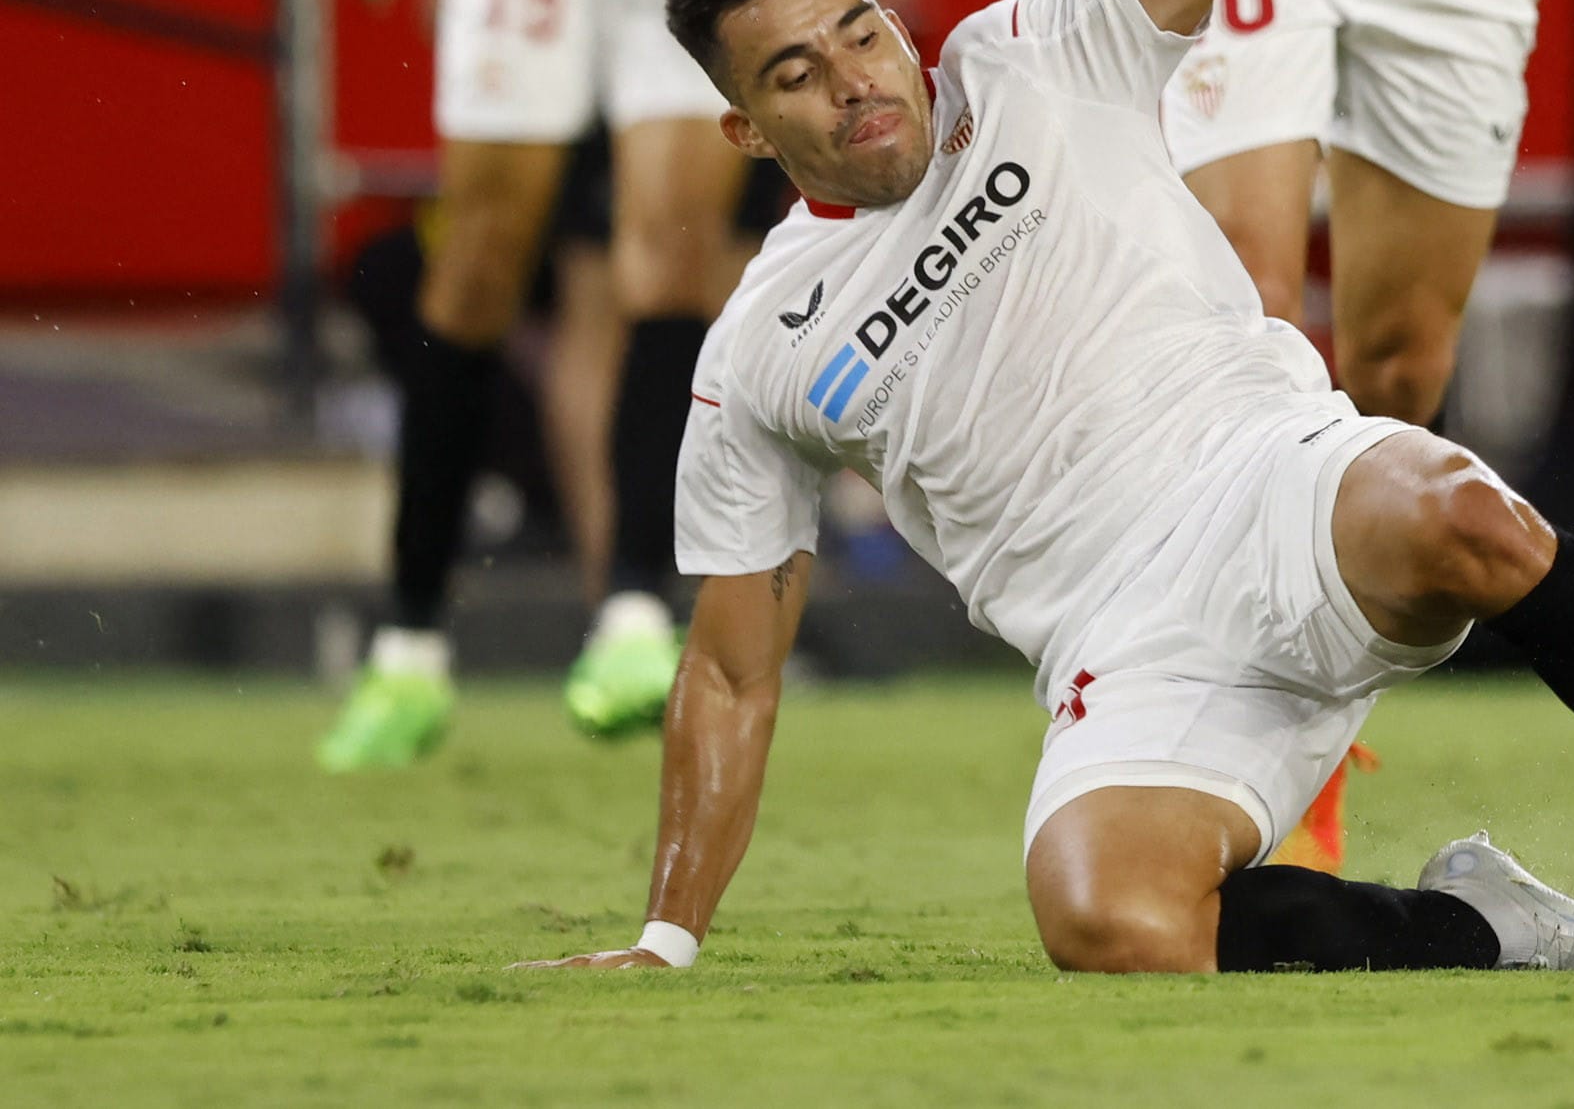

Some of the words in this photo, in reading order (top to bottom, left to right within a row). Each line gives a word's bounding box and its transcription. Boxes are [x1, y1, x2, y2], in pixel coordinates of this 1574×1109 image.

[855, 162, 1030, 360] DEGIRO
[856, 350, 919, 437] EUROPE'S
[917, 271, 982, 351] LEADING
[979, 208, 1047, 274] BROKER
